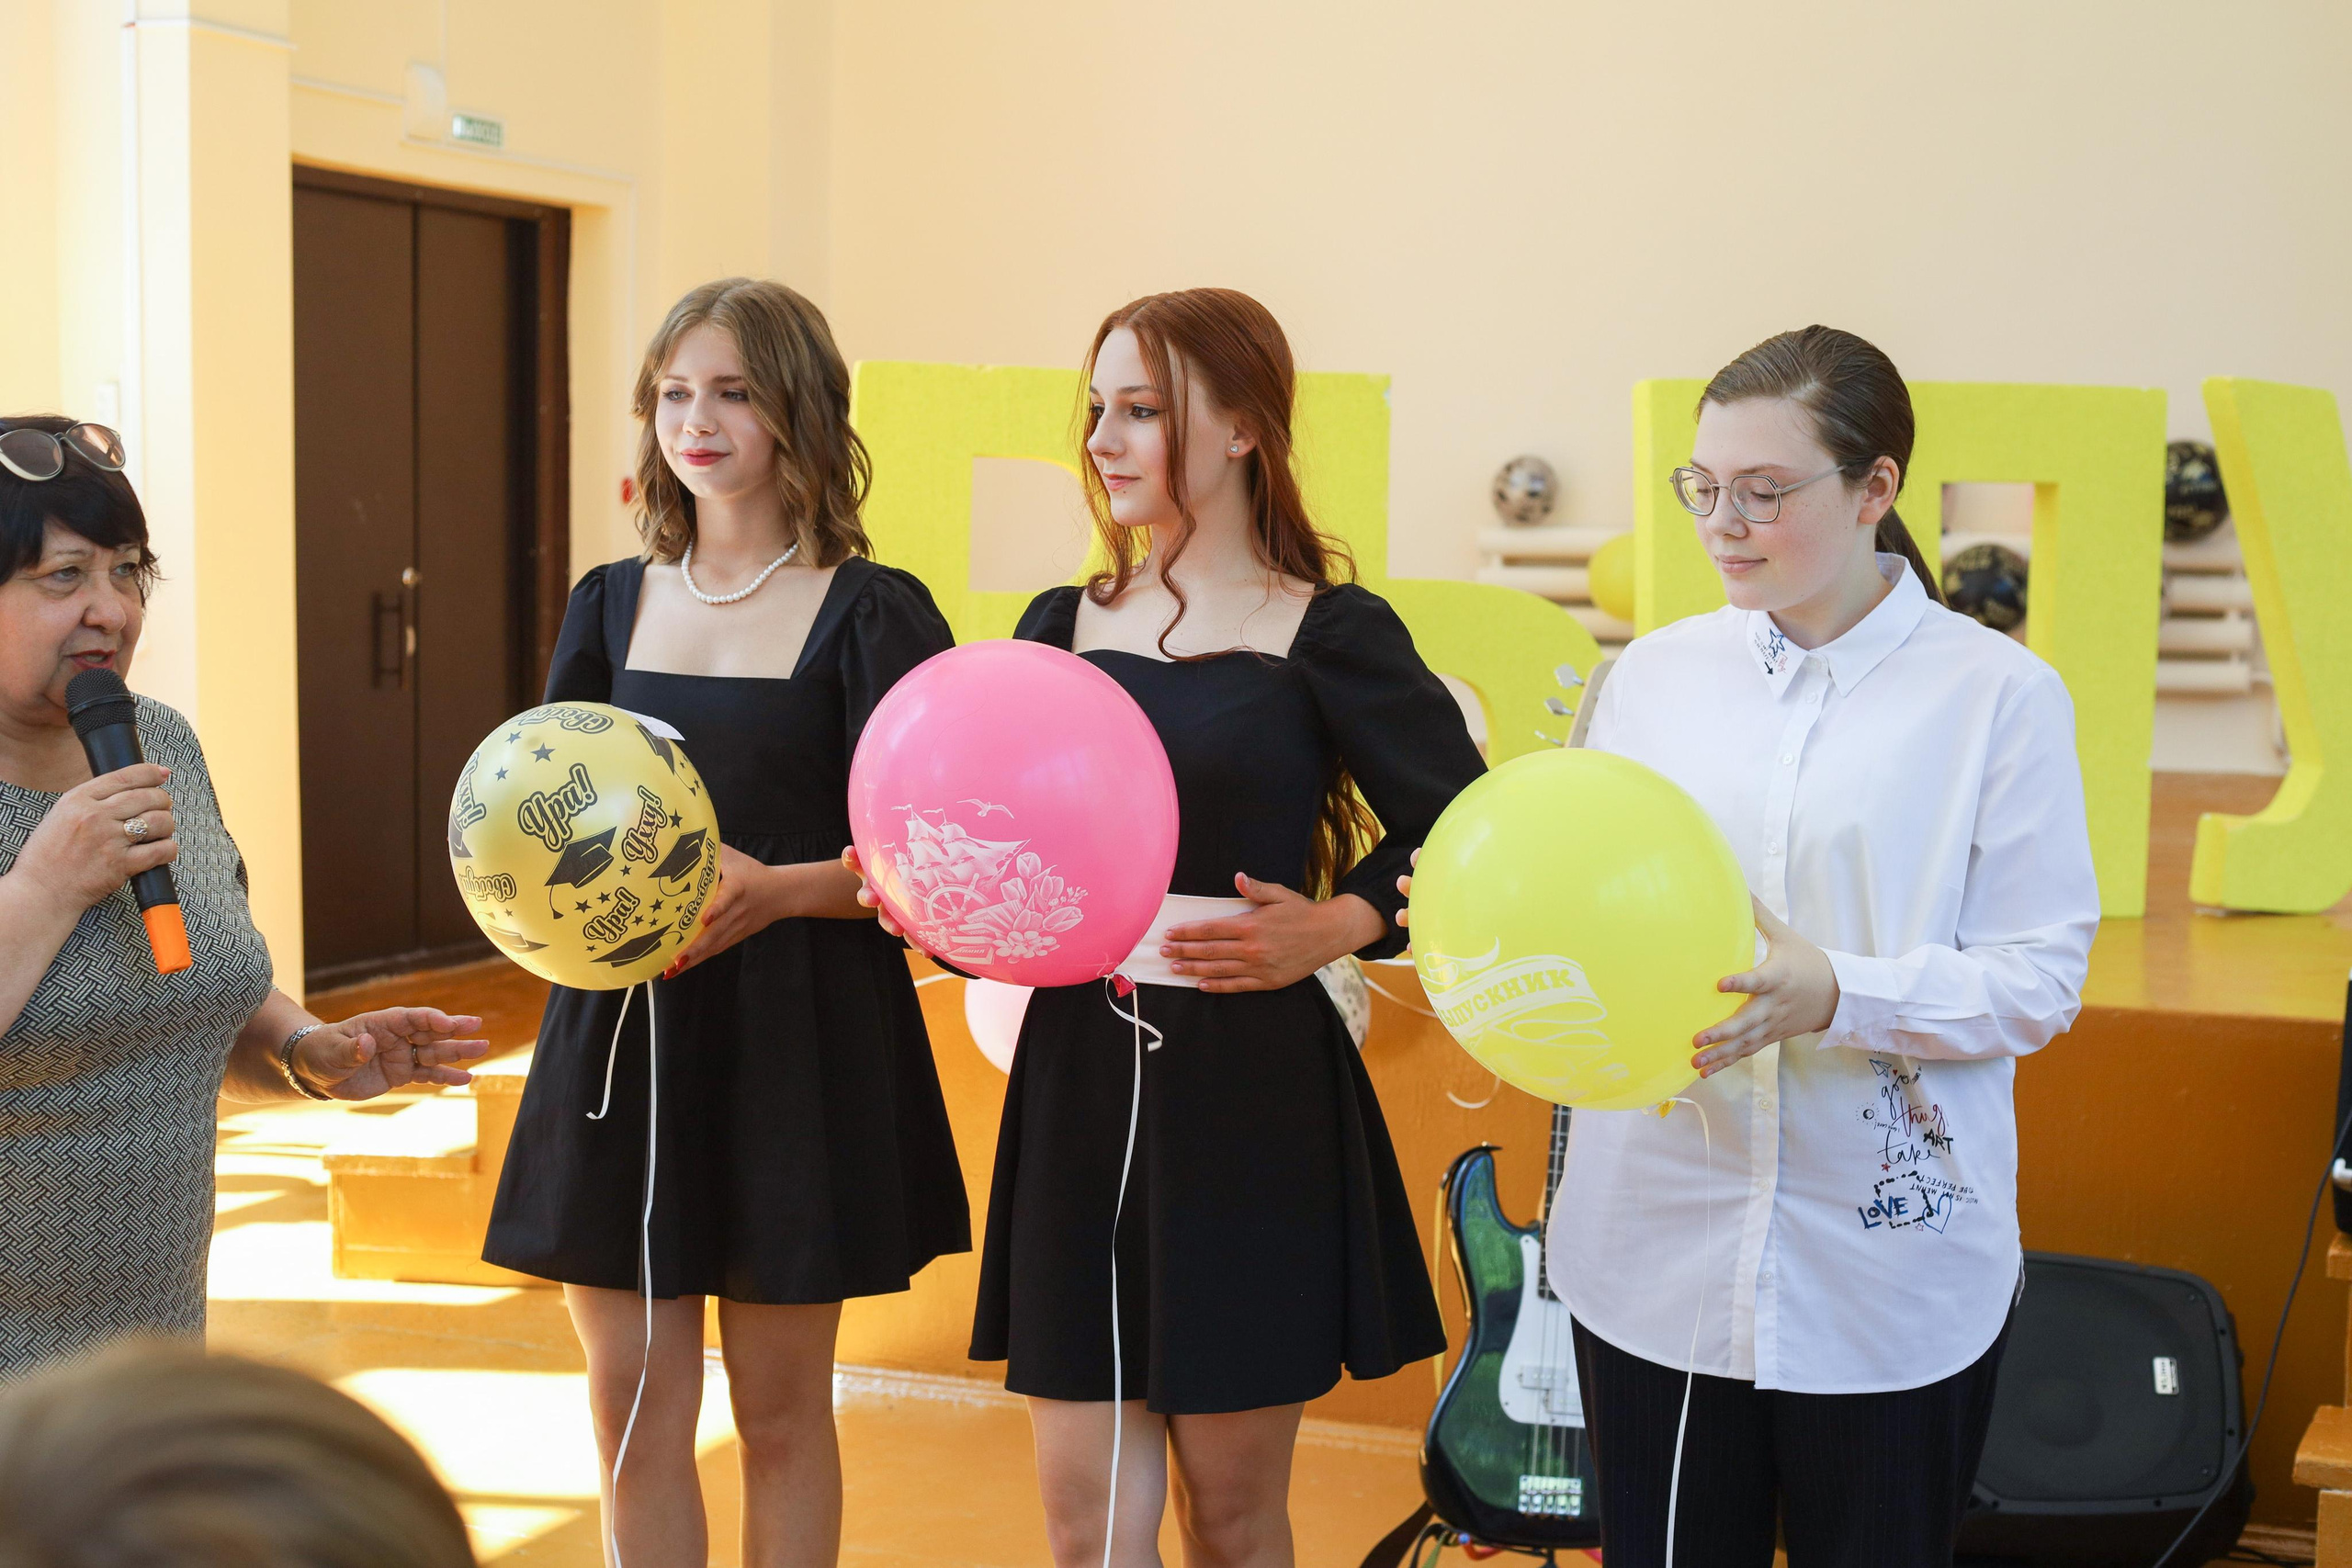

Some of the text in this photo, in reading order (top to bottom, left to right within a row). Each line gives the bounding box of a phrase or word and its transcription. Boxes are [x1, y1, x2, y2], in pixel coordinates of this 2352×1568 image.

[518, 762, 597, 852] Ура!
[621, 784, 668, 864] Ухху!
[582, 886, 640, 943] Ура!
[1923, 1128, 1954, 1155] ART
[1858, 1194, 1909, 1230] LOVE
